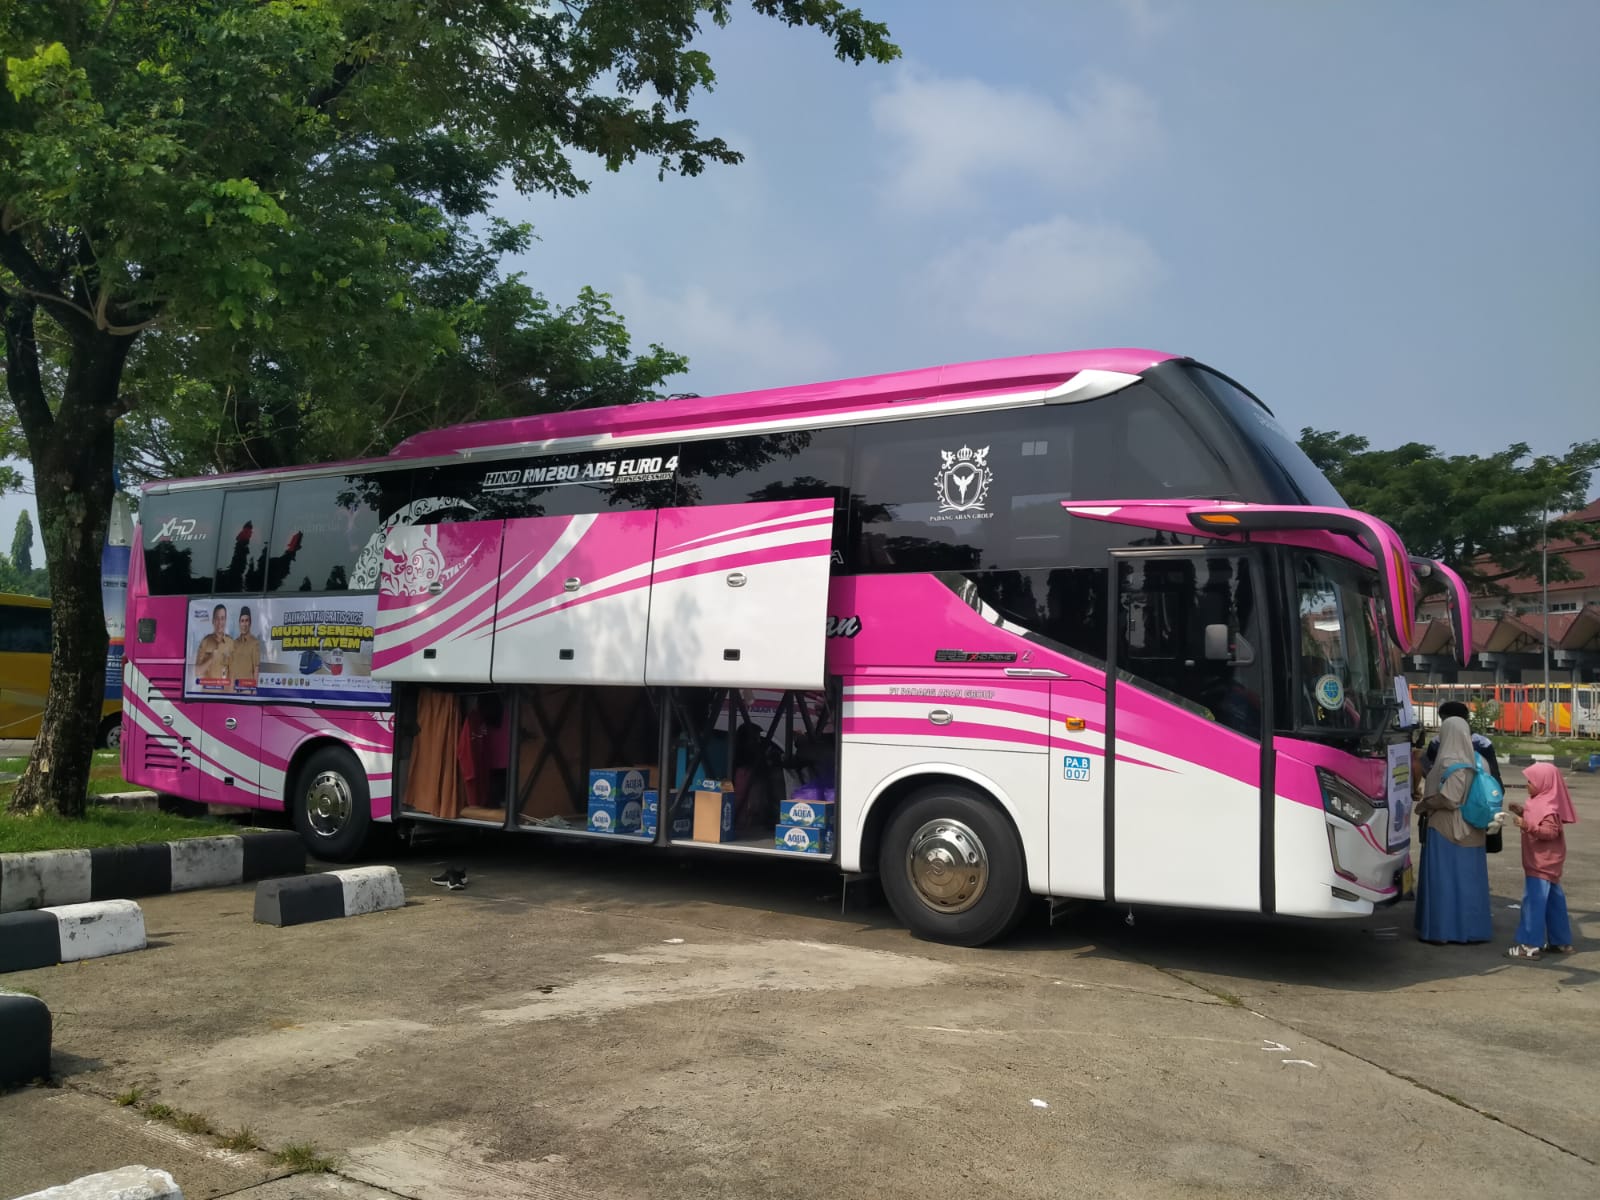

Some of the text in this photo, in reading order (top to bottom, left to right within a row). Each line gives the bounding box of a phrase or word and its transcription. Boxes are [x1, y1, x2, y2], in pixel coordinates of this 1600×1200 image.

[522, 464, 579, 484] RM280
[583, 461, 616, 478] ABS
[618, 457, 662, 475] EURO
[665, 456, 679, 471] 4
[272, 625, 375, 640] MUDIK SENENG
[282, 637, 360, 651] BALIK AYEM
[1065, 757, 1088, 769] PA.B
[1066, 769, 1087, 779] 007
[792, 808, 812, 818] AQUA
[787, 833, 806, 843] AQUA
